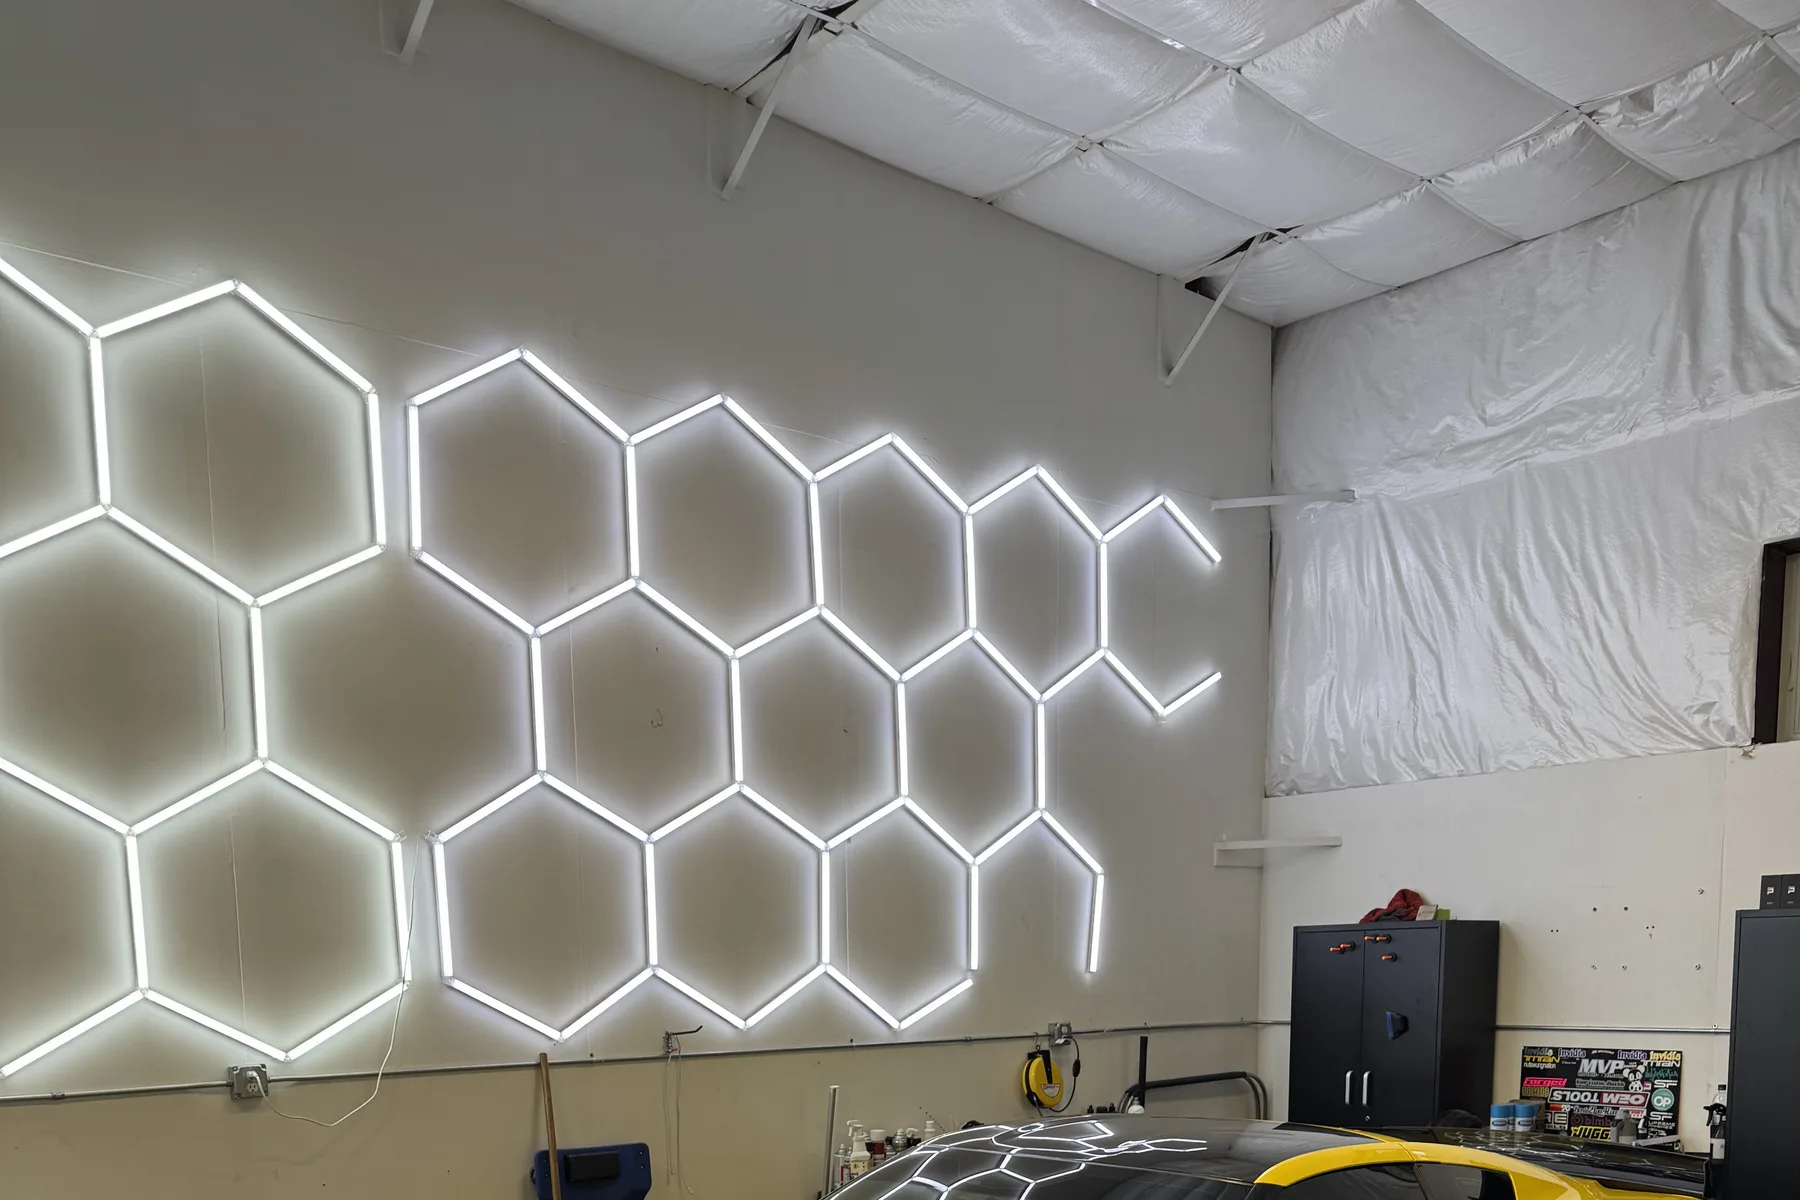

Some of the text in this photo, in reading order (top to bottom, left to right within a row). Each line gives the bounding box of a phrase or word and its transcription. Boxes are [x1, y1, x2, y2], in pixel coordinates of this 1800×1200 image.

[1578, 1058, 1625, 1075] MVP
[1551, 1090, 1599, 1103] TOOLS
[1602, 1093, 1645, 1105] OEM
[1653, 1096, 1672, 1107] OP
[1576, 1126, 1611, 1141] JUGG
